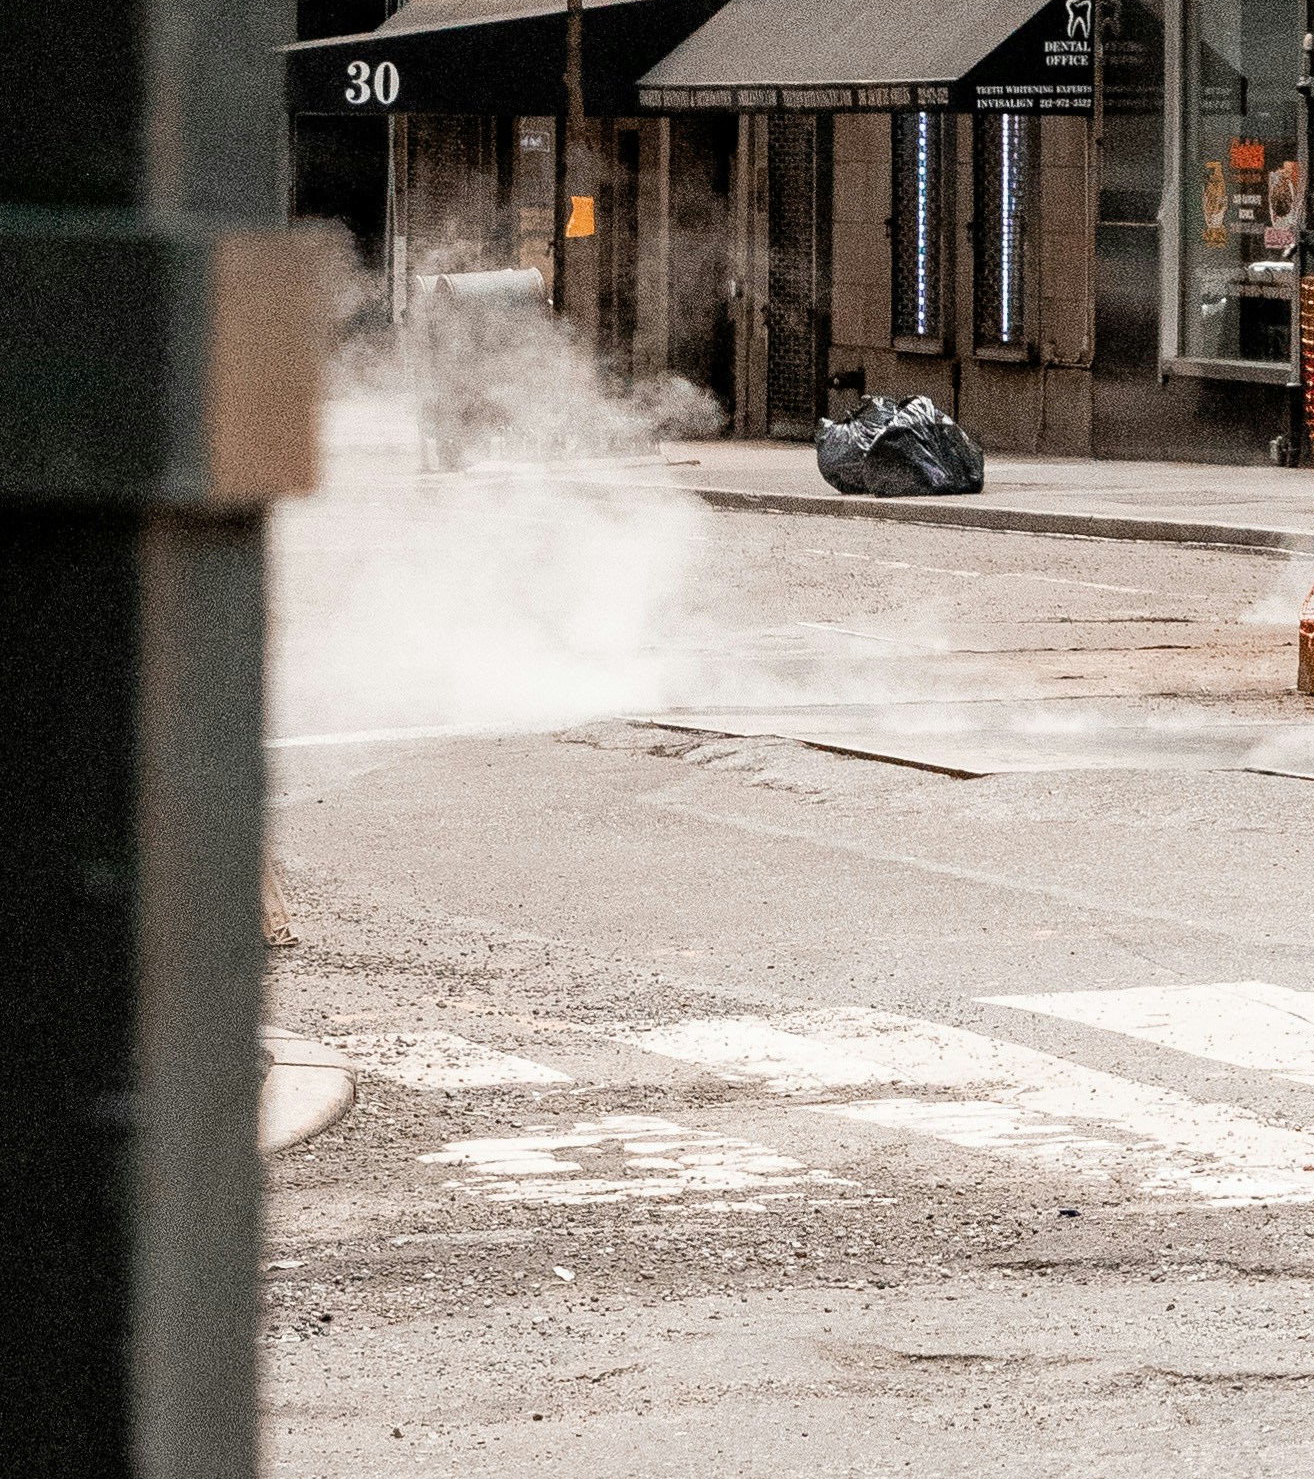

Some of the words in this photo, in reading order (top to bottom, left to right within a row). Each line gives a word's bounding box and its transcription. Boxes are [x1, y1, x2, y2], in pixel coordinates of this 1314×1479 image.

[1044, 41, 1091, 53] DENTAL
[1046, 55, 1089, 66] OFFICE
[346, 60, 400, 104] 30
[976, 86, 1003, 95] TEETH
[1005, 86, 1054, 95] WHITENING
[1056, 85, 1092, 94] EXPERTS
[977, 99, 1033, 108] INVISALIGN
